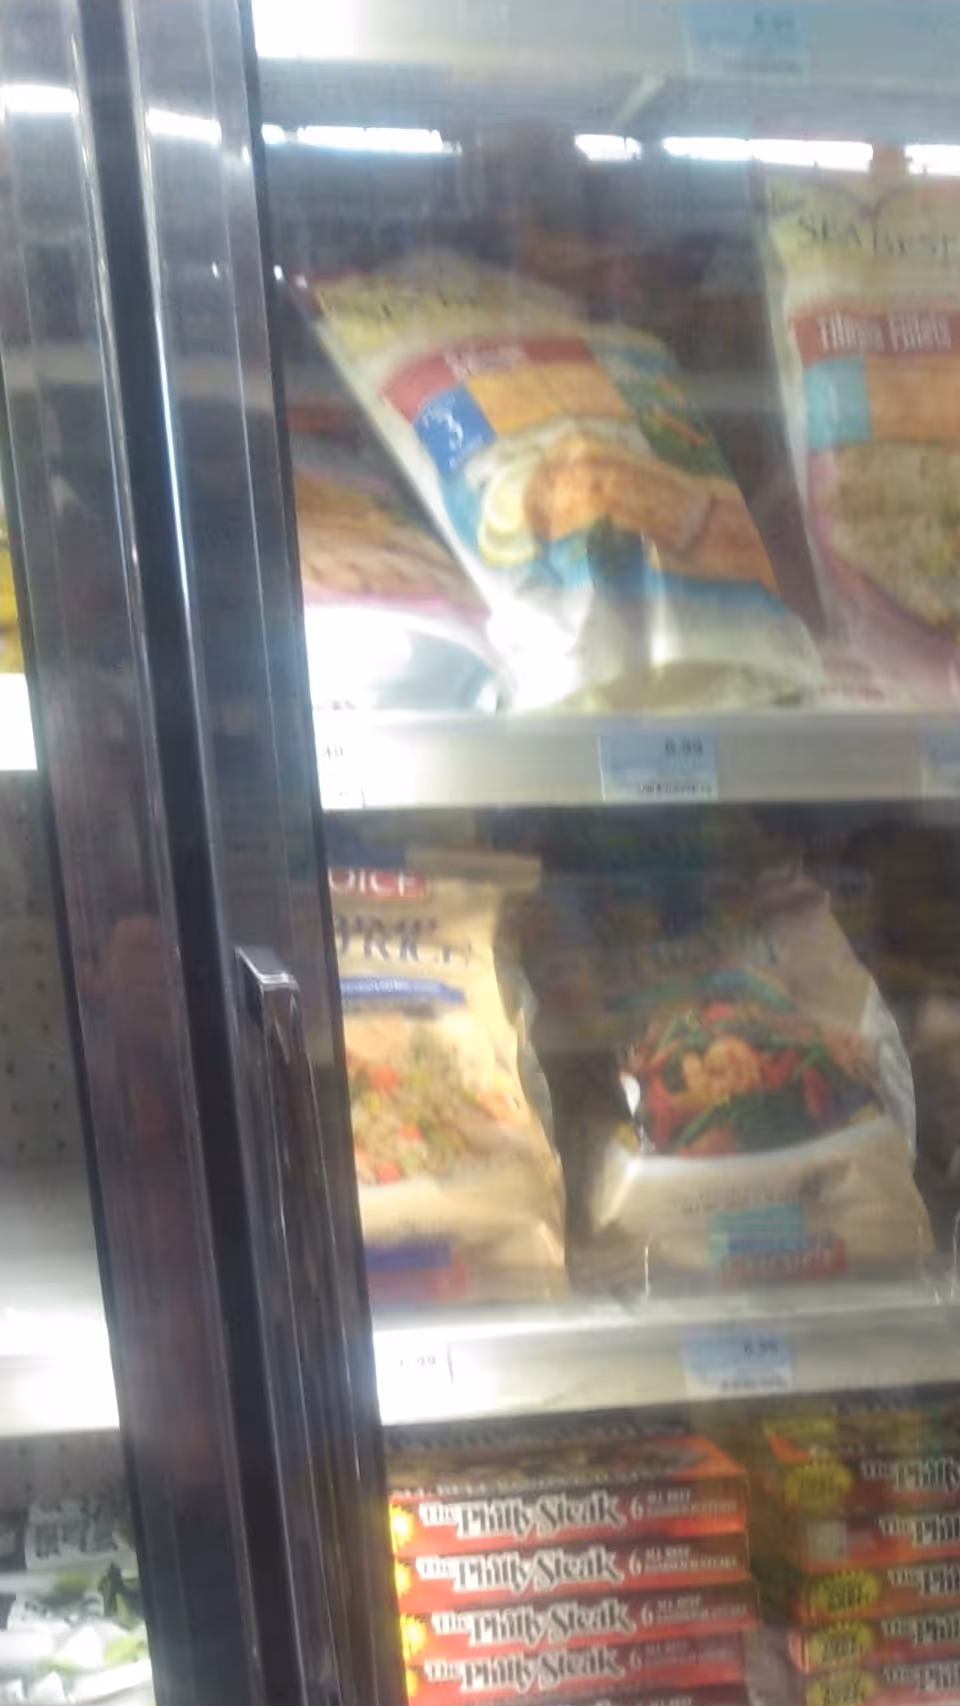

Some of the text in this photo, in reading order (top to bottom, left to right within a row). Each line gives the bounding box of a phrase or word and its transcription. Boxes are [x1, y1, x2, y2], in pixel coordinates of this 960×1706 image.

[420, 1491, 643, 1540] The Philly Steak 6
[416, 1546, 642, 1594] The Philly Steak 6
[431, 1599, 653, 1647] The Philly Steak 6
[424, 1642, 642, 1692] The Philly Steak 6
